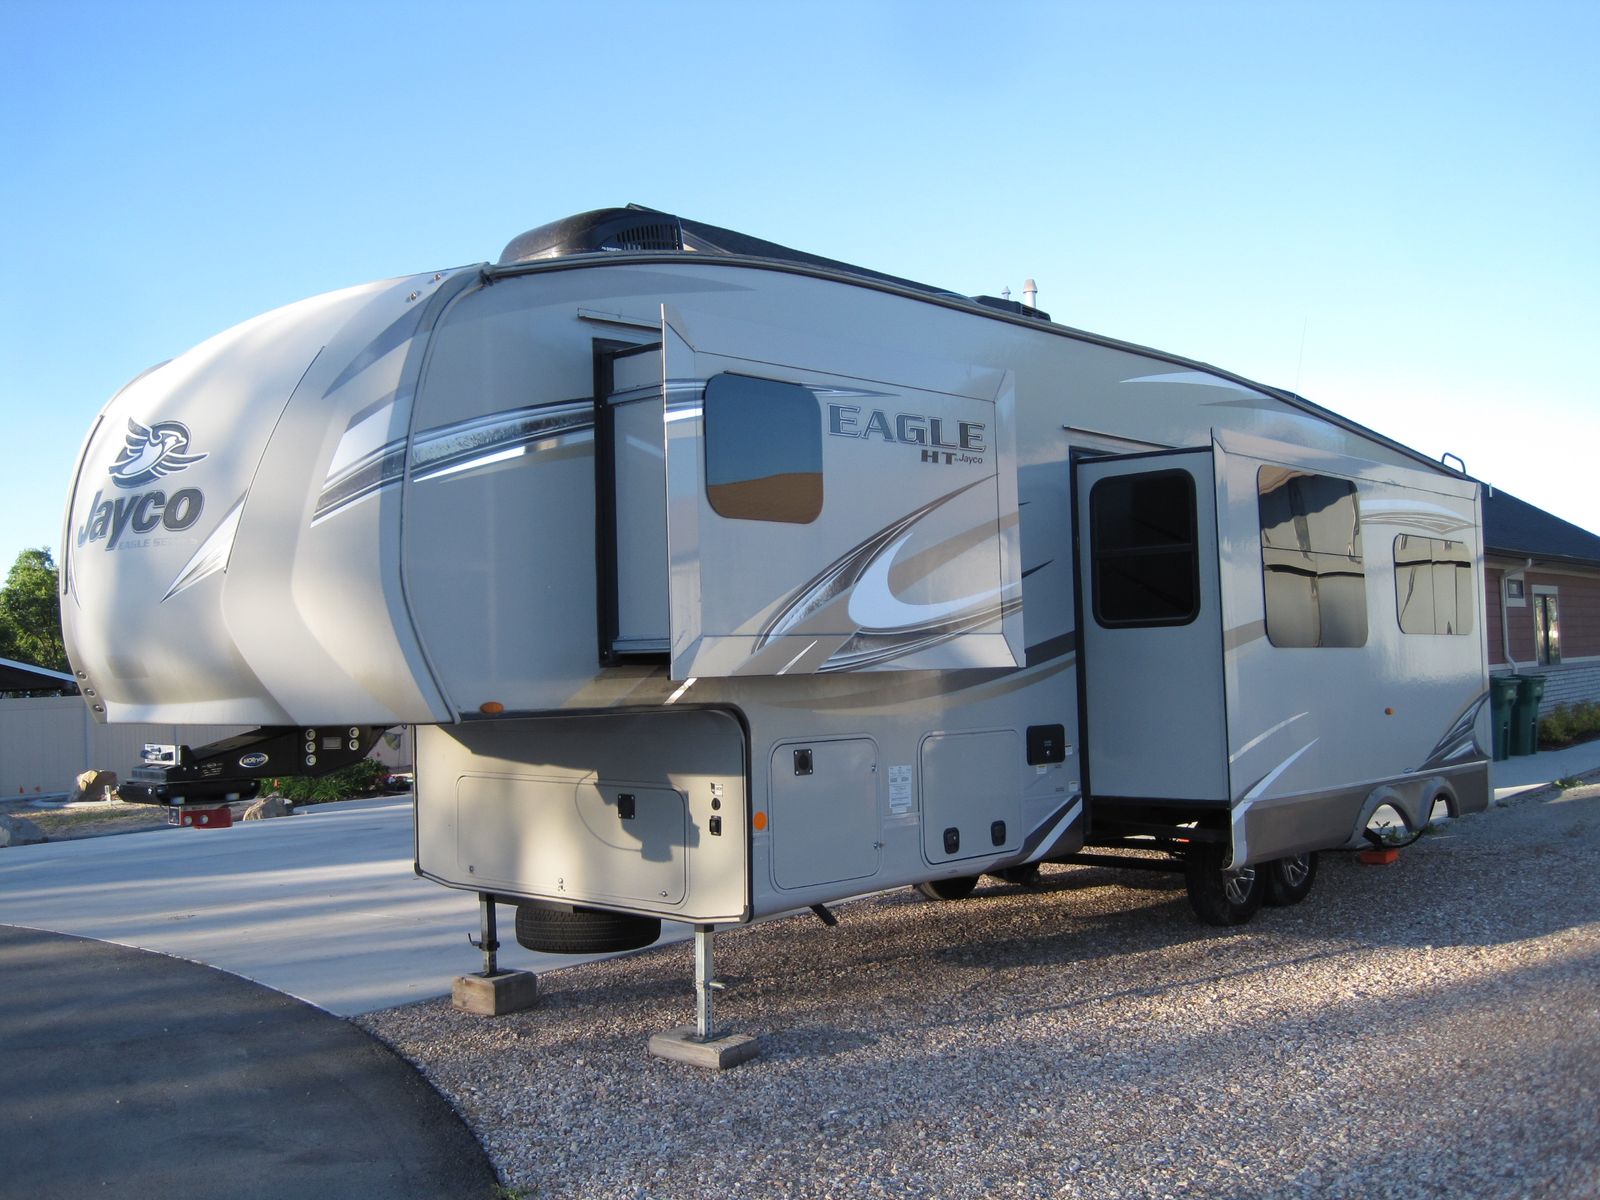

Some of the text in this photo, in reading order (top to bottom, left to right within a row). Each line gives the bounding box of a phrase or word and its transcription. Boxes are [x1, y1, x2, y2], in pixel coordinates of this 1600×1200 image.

[827, 402, 986, 452] EAGLE
[920, 449, 983, 465] HT Jayco
[77, 486, 205, 551] Jayco
